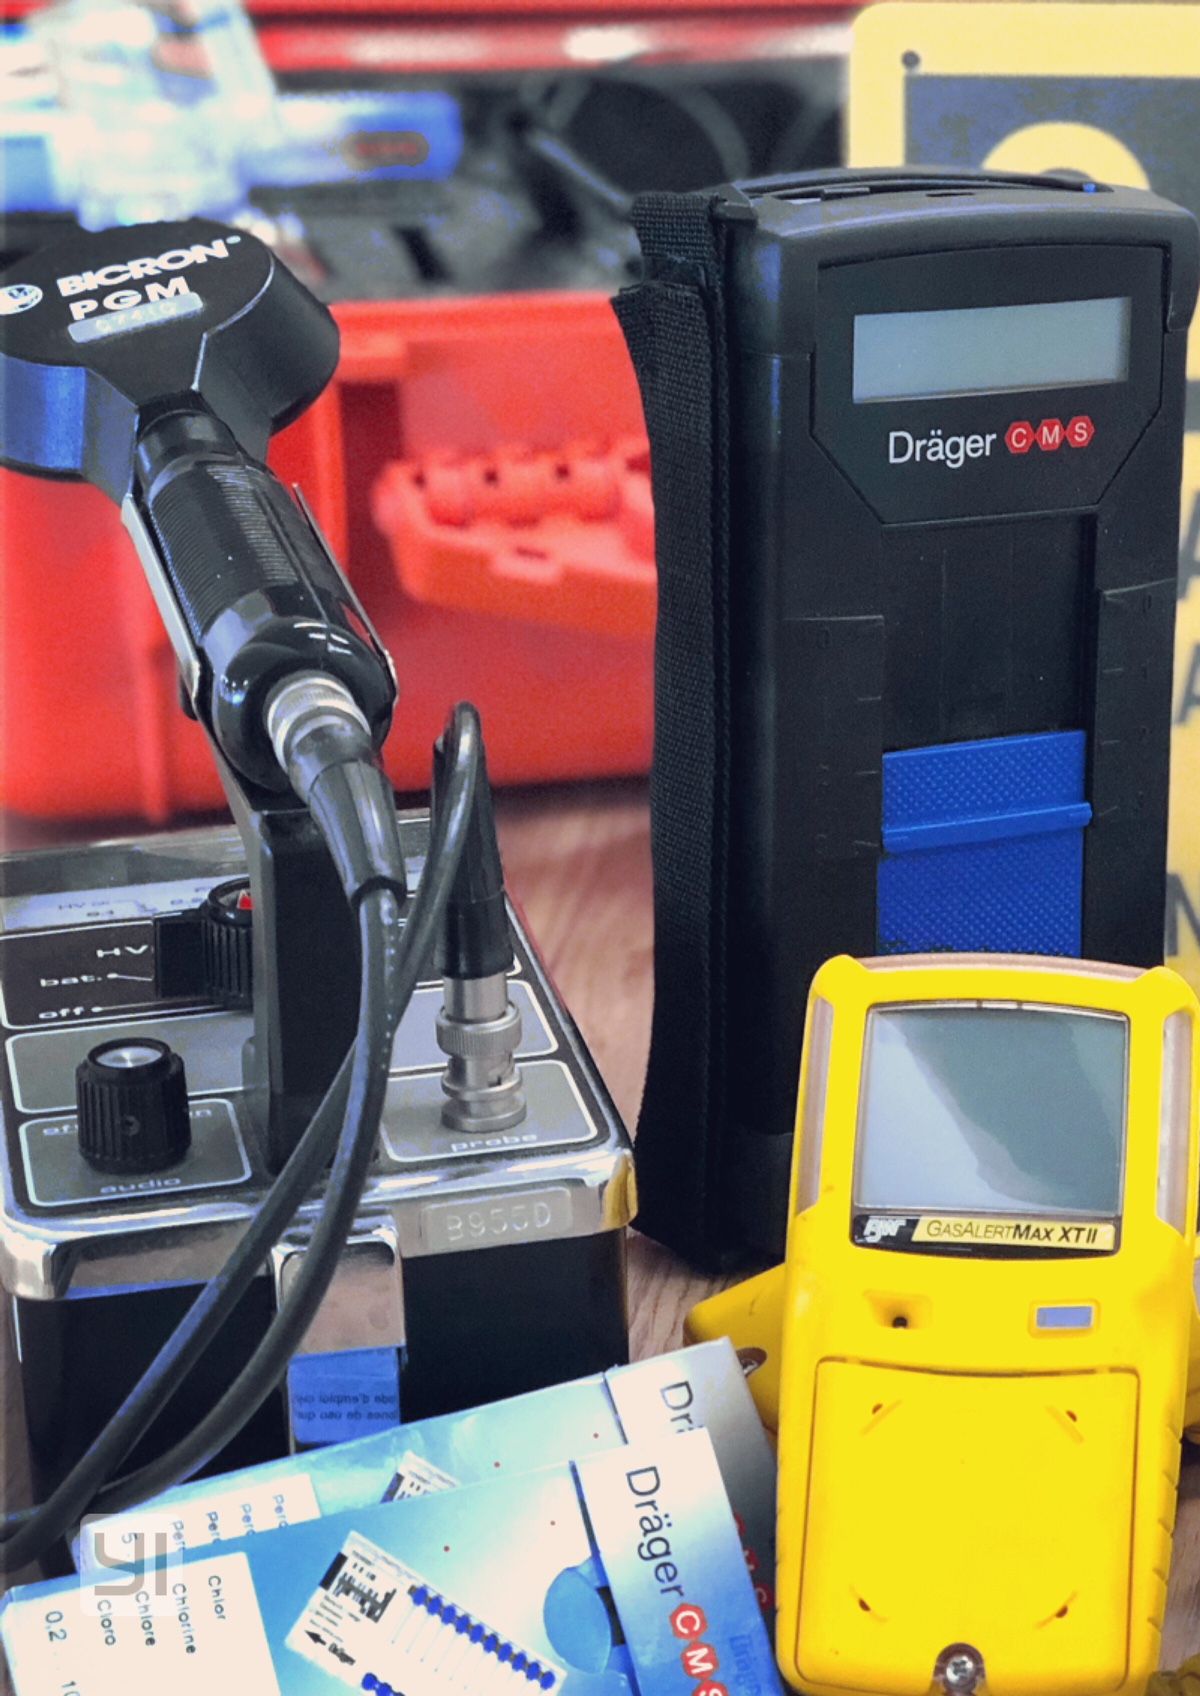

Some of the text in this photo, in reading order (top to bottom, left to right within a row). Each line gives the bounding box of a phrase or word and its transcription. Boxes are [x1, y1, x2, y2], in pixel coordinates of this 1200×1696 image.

[57, 239, 230, 297] BICRON
[69, 276, 192, 320] PGM
[888, 429, 997, 468] Dräger
[96, 944, 149, 958] HV
[38, 1006, 84, 1019] off
[451, 1133, 538, 1152] probe
[100, 1177, 182, 1194] audio
[626, 1465, 685, 1597] Dräger
[135, 1590, 156, 1646] Chlore
[172, 1583, 196, 1654] Chlorine
[207, 1575, 227, 1621] Chlor
[97, 1599, 116, 1646] Cloro
